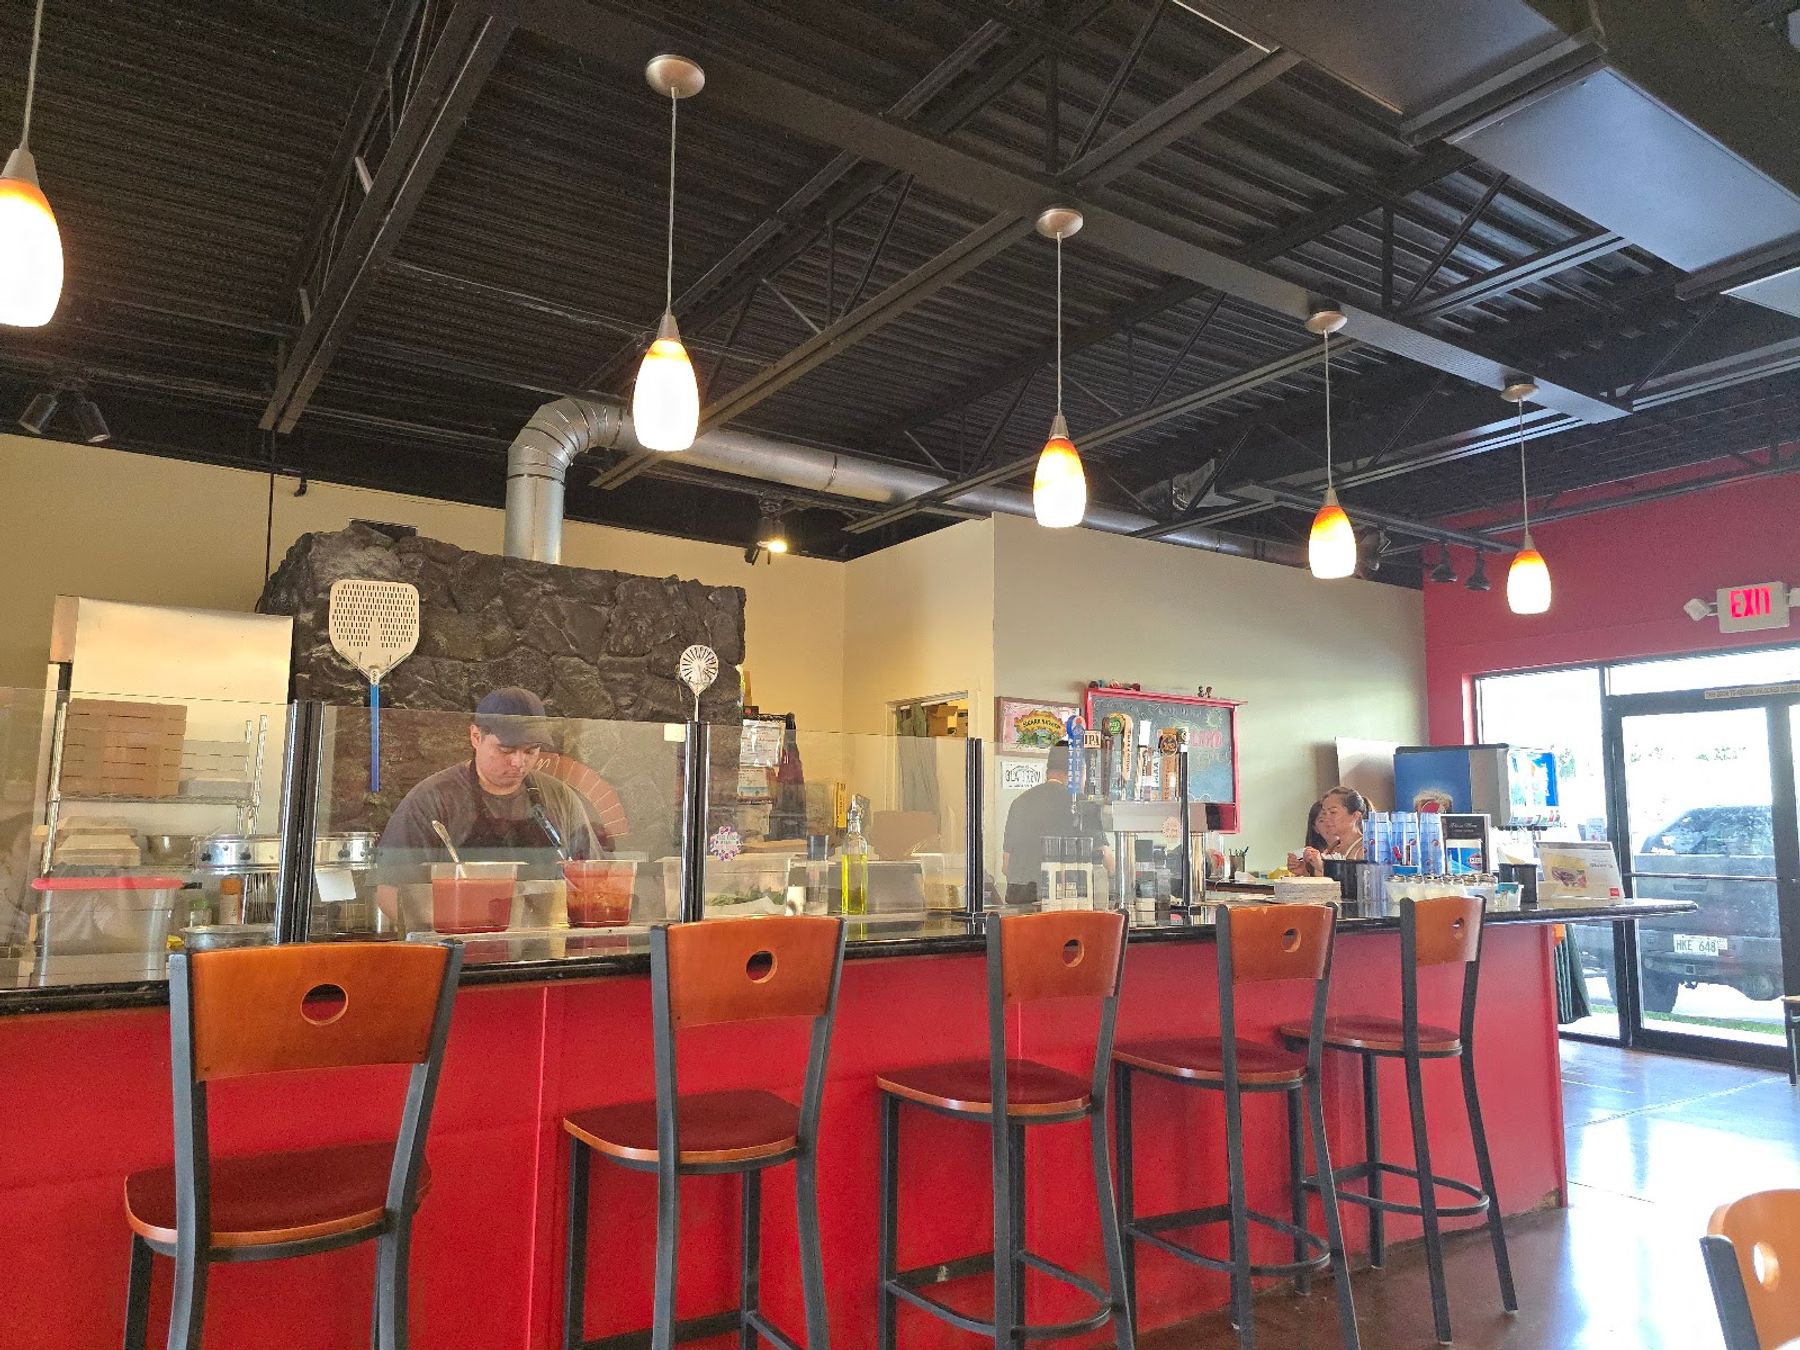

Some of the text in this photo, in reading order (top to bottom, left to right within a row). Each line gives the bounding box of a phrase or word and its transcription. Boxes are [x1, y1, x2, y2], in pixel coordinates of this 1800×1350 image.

[1730, 586, 1771, 618] EXIT
[1084, 734, 1100, 746] IPA
[1676, 939, 1716, 952] HKE 648
